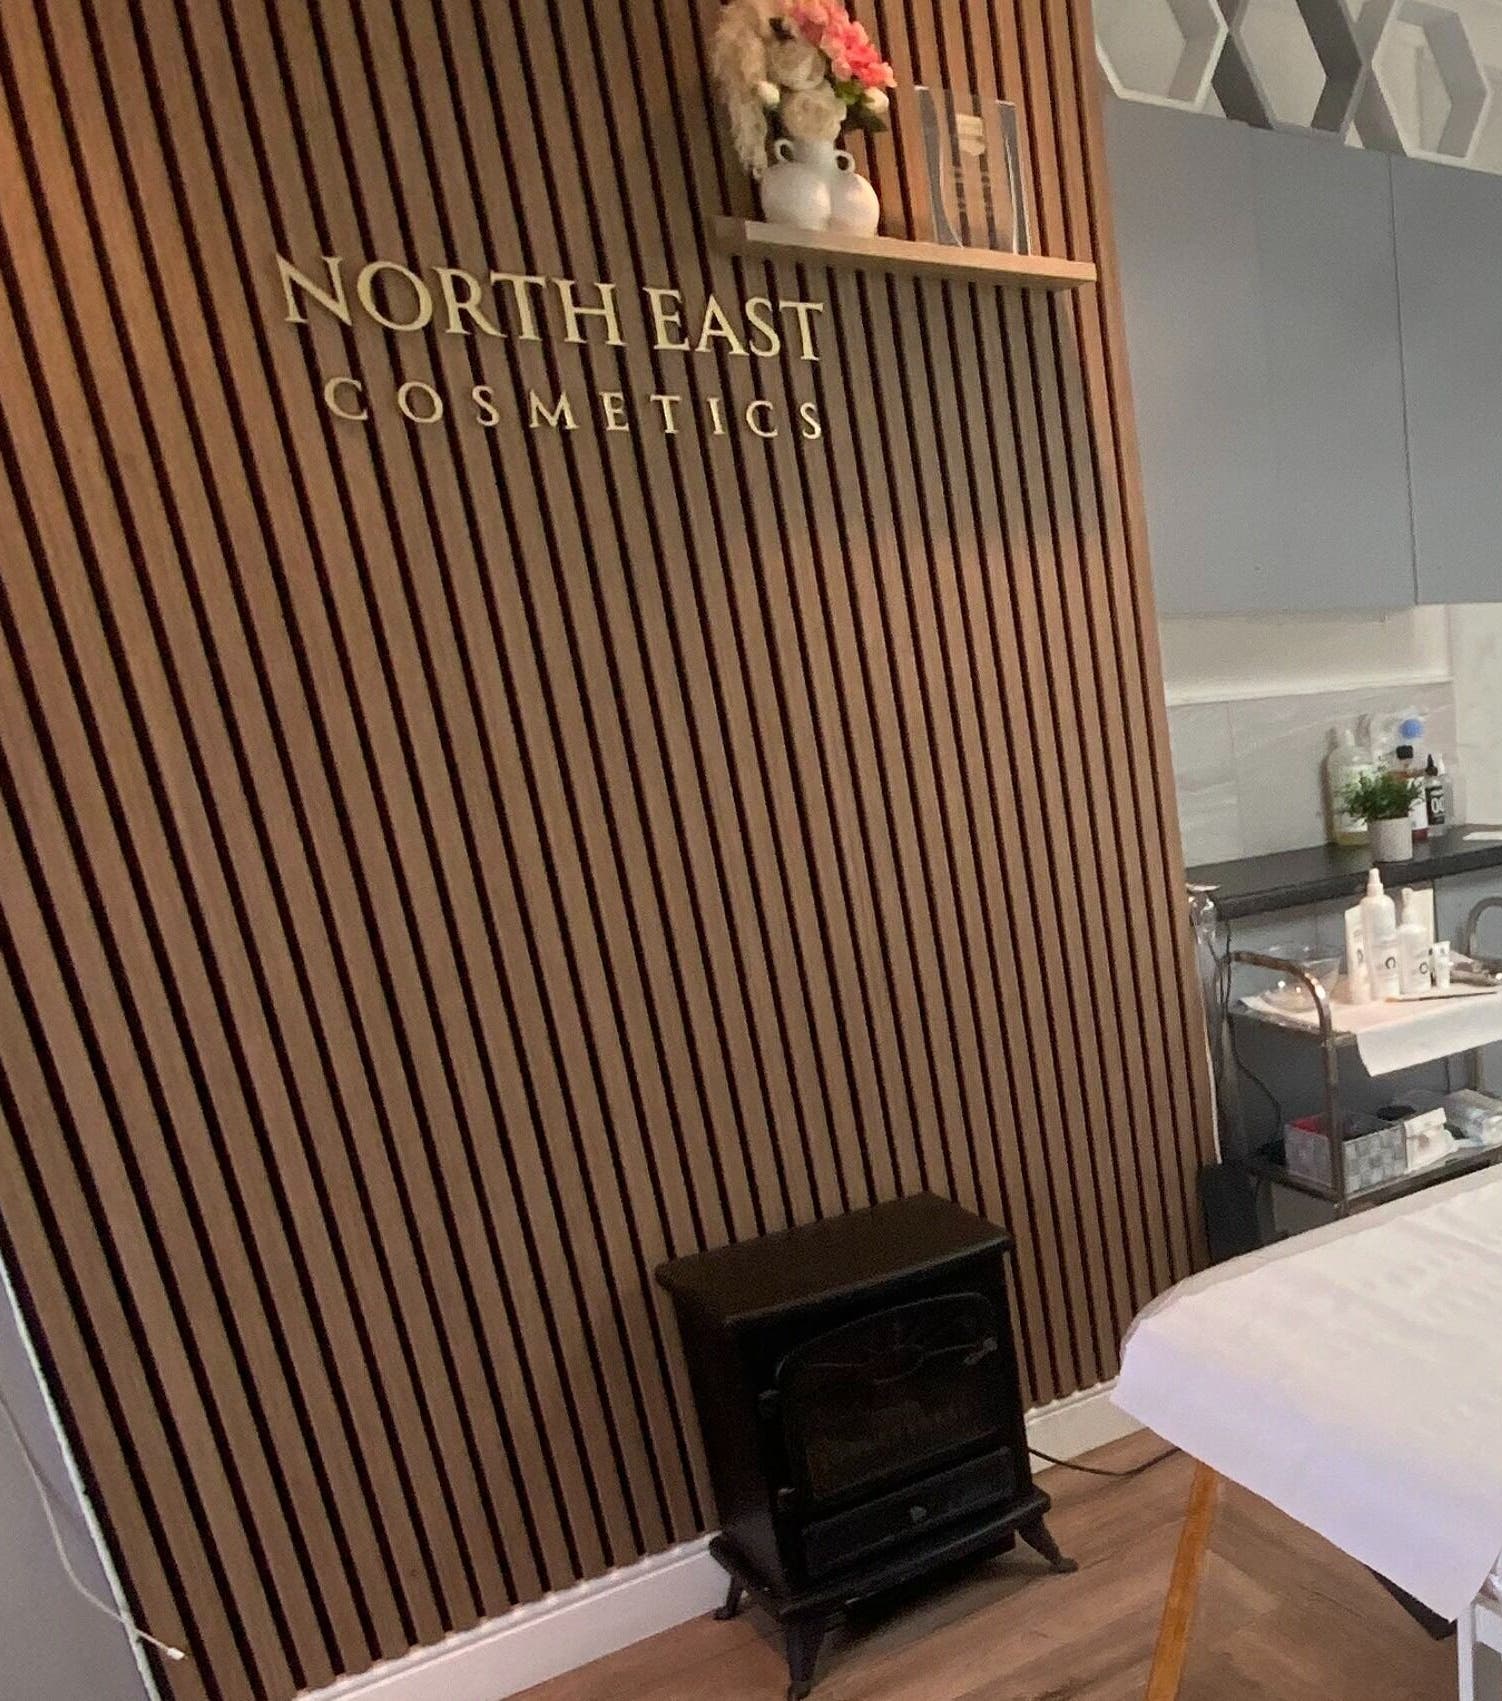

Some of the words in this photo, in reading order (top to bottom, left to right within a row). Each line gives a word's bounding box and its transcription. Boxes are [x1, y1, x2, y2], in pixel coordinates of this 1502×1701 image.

[276, 251, 627, 347] NORTH
[642, 284, 824, 361] EAST
[323, 376, 822, 440] COSMETICS
